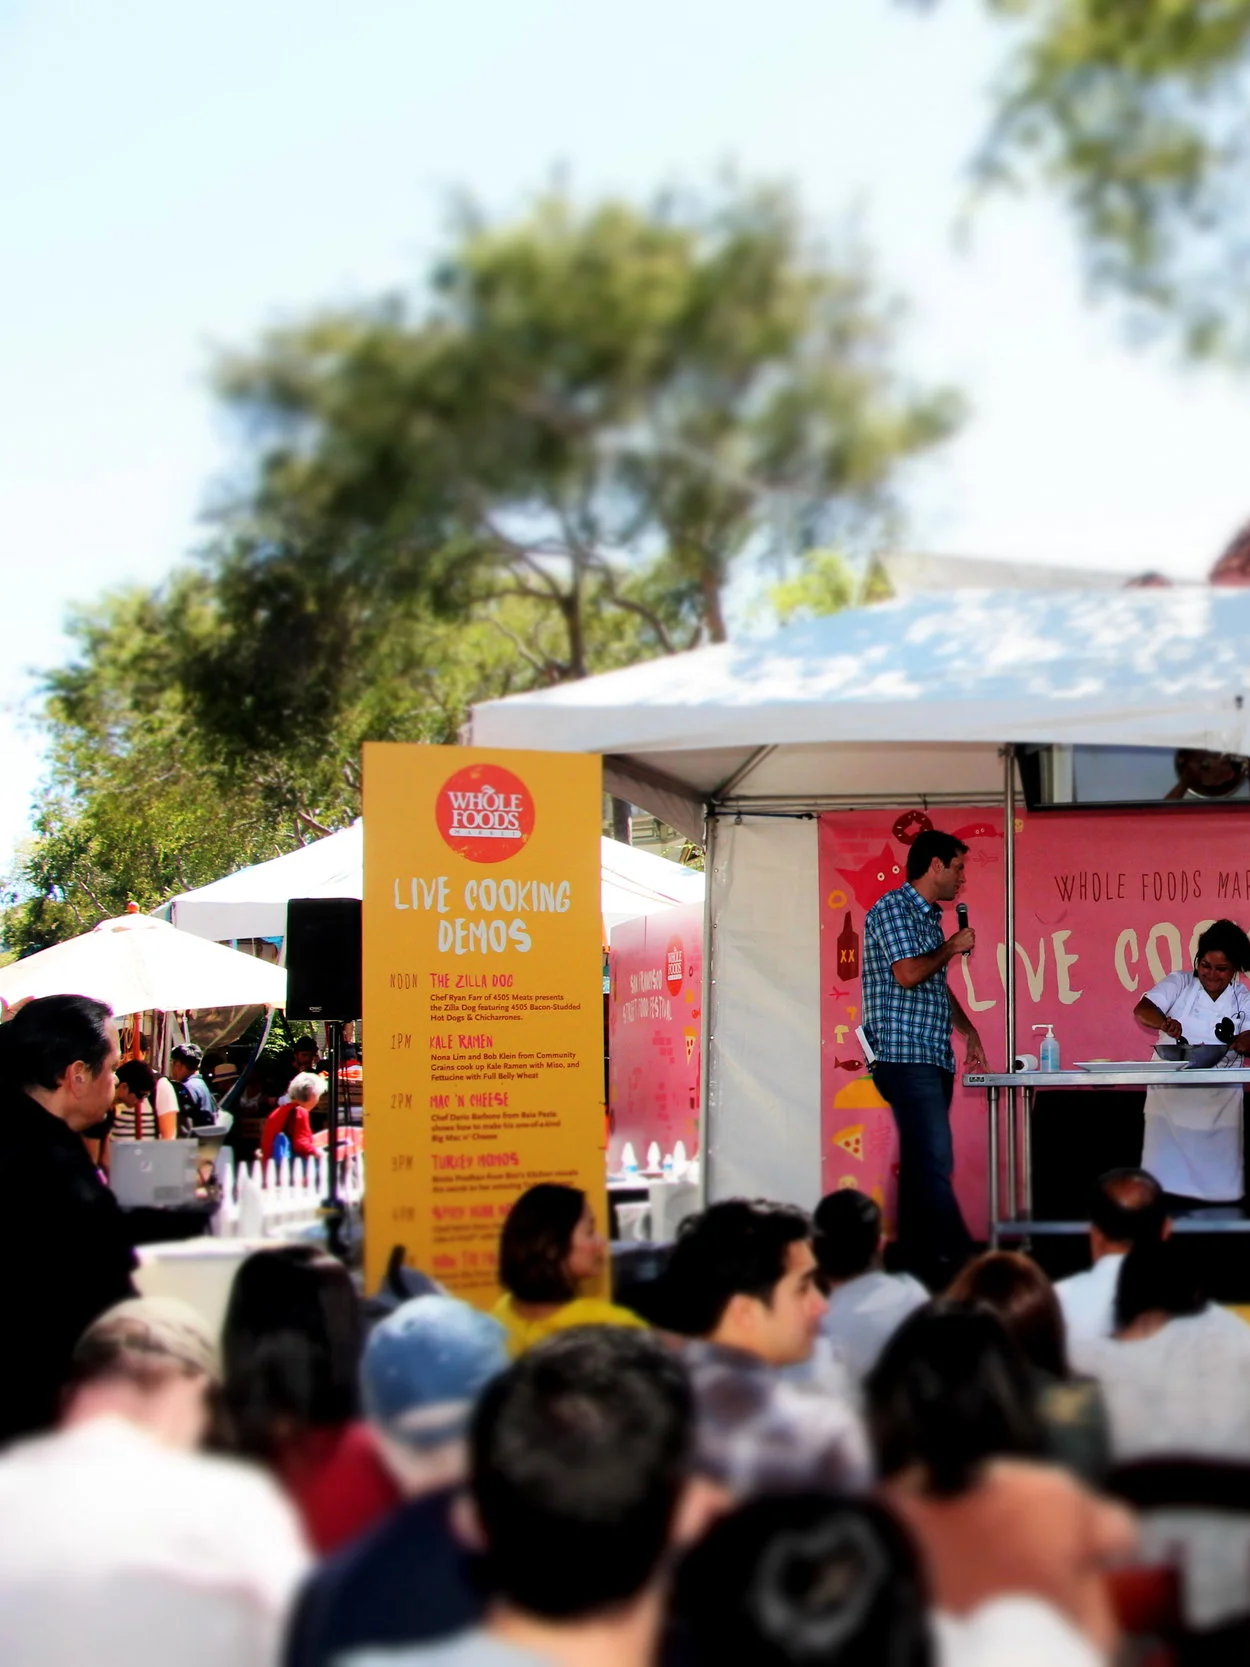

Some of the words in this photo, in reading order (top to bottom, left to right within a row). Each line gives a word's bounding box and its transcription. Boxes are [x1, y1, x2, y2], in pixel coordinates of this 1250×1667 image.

[447, 789, 523, 812] WHOLE
[452, 809, 520, 830] FOODS
[393, 876, 450, 914] LIVE
[464, 878, 571, 913] COOKING
[1054, 871, 1126, 902] WHOLE
[1141, 870, 1202, 903] FOODS
[438, 917, 532, 955] DEMOS
[390, 973, 418, 990] NOON
[429, 972, 449, 989] THE
[455, 974, 487, 988] ZILLA
[492, 974, 514, 988] DOG
[430, 993, 448, 1001] Chef
[449, 993, 466, 1003] Ryan
[468, 993, 482, 1001] Farr
[484, 993, 492, 1001] of
[493, 993, 509, 1001] 4505
[512, 993, 532, 1001] Meats
[535, 993, 564, 1002] presents
[430, 1003, 442, 1011] the
[444, 1003, 459, 1011] Zilla
[461, 1004, 476, 1013] Dog
[478, 1003, 509, 1013] featuring
[511, 1003, 528, 1011] 4505
[530, 1003, 581, 1011] Bacon-Studded
[446, 1014, 465, 1023] Dogs
[466, 1013, 473, 1021] &
[391, 1032, 412, 1050] 1PM
[429, 1034, 453, 1050] KALE
[458, 1033, 494, 1049] RAMEN
[453, 1053, 466, 1061] Lim
[483, 1052, 497, 1060] Bob
[499, 1052, 517, 1060] Klein
[518, 1051, 535, 1060] from
[536, 1051, 577, 1060] Community
[431, 1063, 455, 1071] Grains
[456, 1063, 473, 1071] cook
[475, 1064, 485, 1072] up
[487, 1062, 502, 1070] Kale
[503, 1062, 528, 1070] Ramen
[529, 1061, 544, 1069] with
[466, 1073, 481, 1081] with
[483, 1072, 497, 1080] Full
[498, 1071, 514, 1081] Belly
[390, 1092, 413, 1110] 2PM
[429, 1093, 450, 1109] MAC
[469, 1092, 509, 1108] CHEESE
